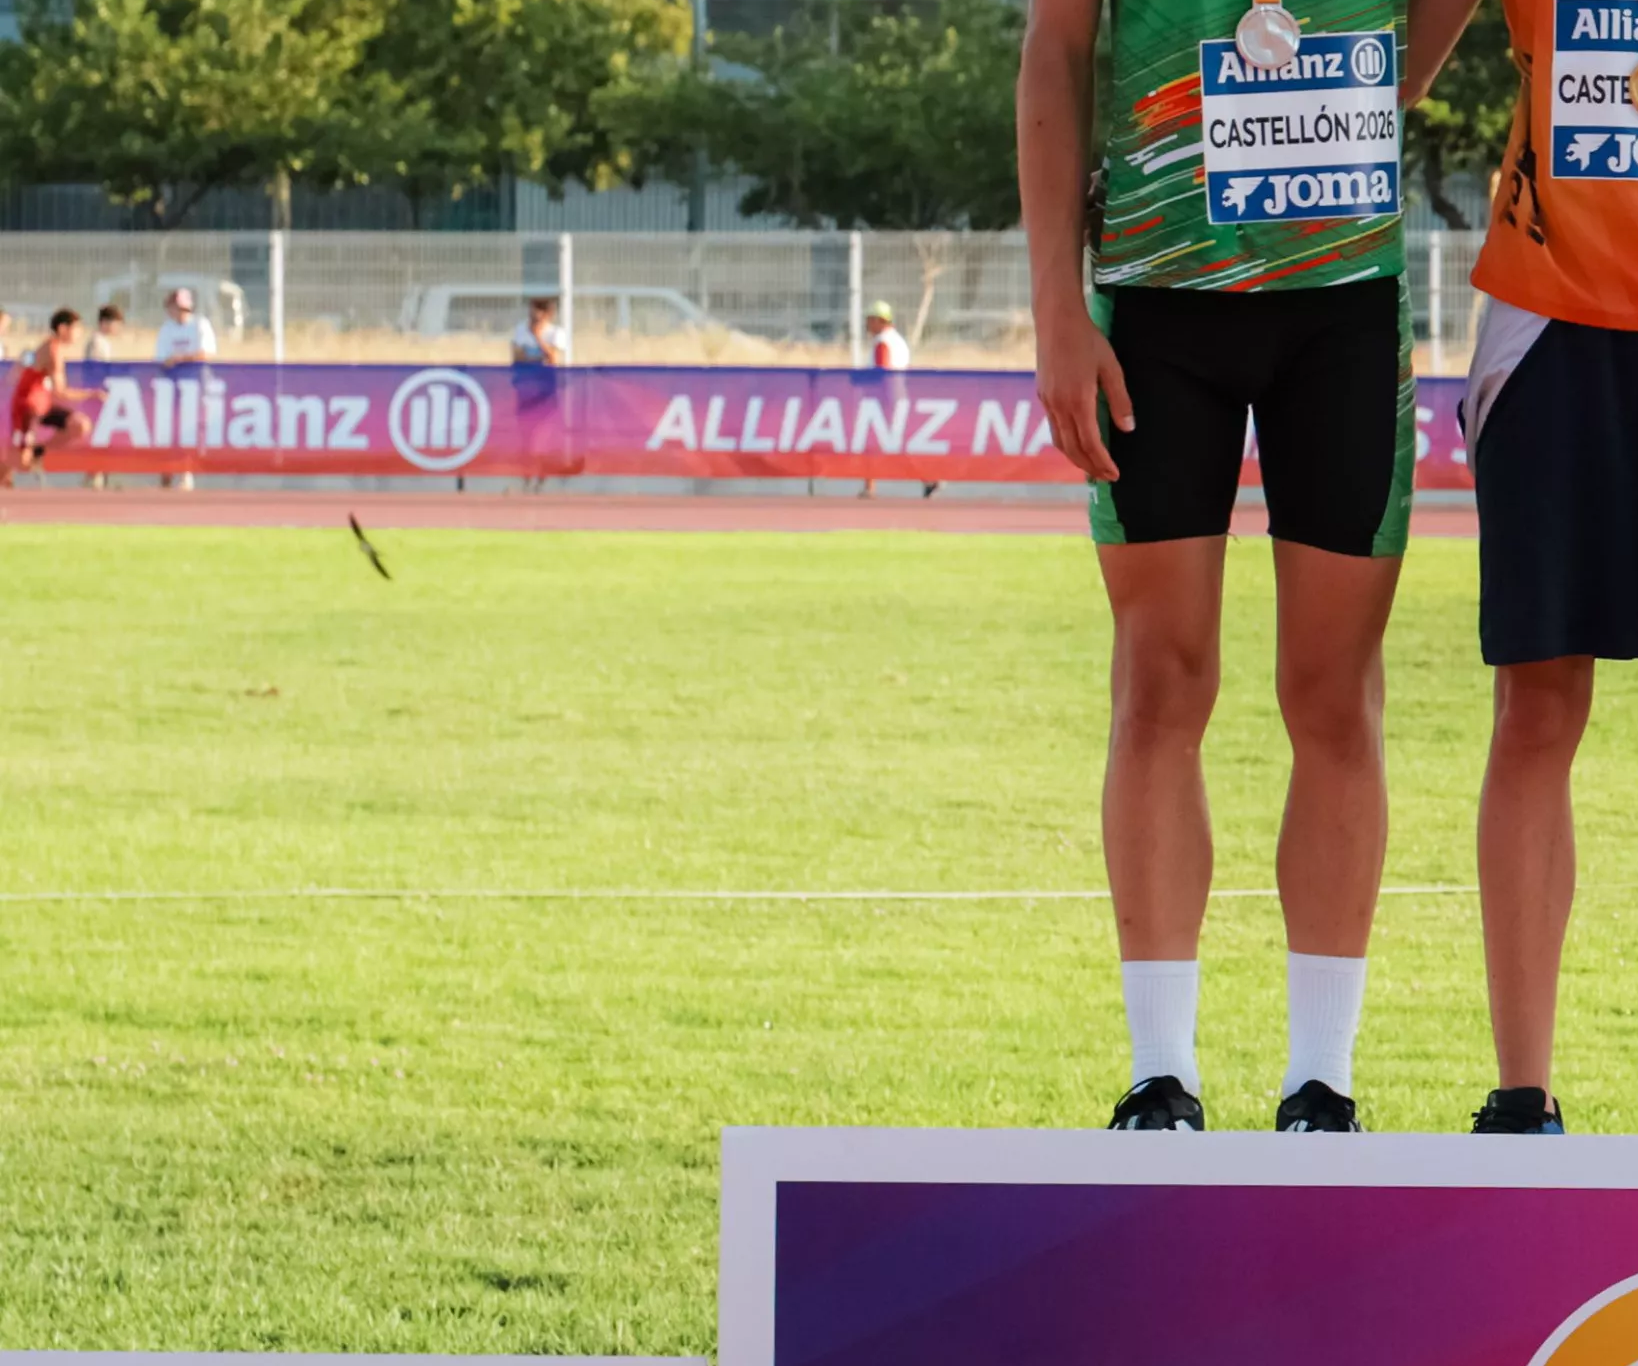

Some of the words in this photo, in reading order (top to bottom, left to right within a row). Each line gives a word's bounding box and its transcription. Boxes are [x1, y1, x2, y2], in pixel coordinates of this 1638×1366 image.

[1209, 105, 1350, 148] CASTELLÓN
[1355, 110, 1395, 141] 2026
[91, 376, 369, 450] Allianz
[645, 394, 958, 456] ALLIANZ
